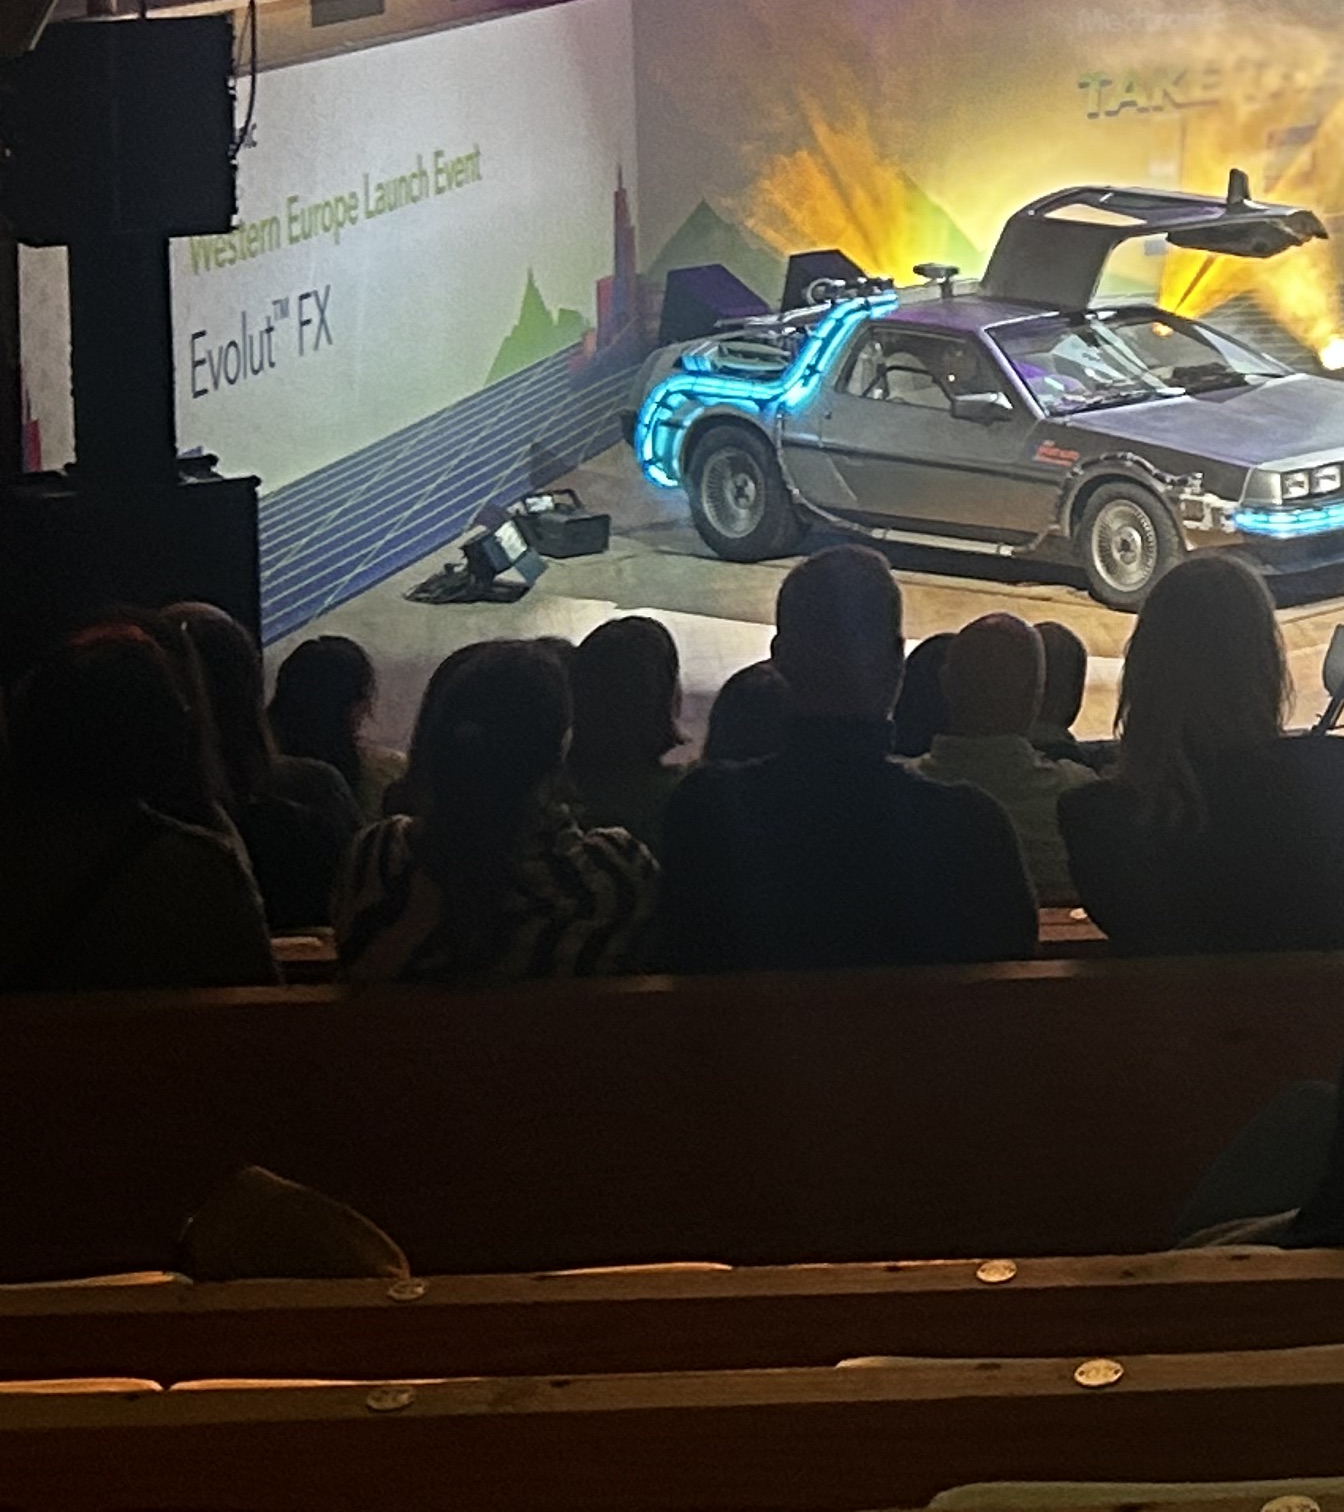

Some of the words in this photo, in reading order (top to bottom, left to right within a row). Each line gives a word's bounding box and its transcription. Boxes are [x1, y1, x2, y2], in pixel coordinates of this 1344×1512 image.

[286, 193, 359, 246] Europe
[363, 153, 430, 220] Launch
[433, 143, 483, 195] Event
[297, 283, 333, 357] FX
